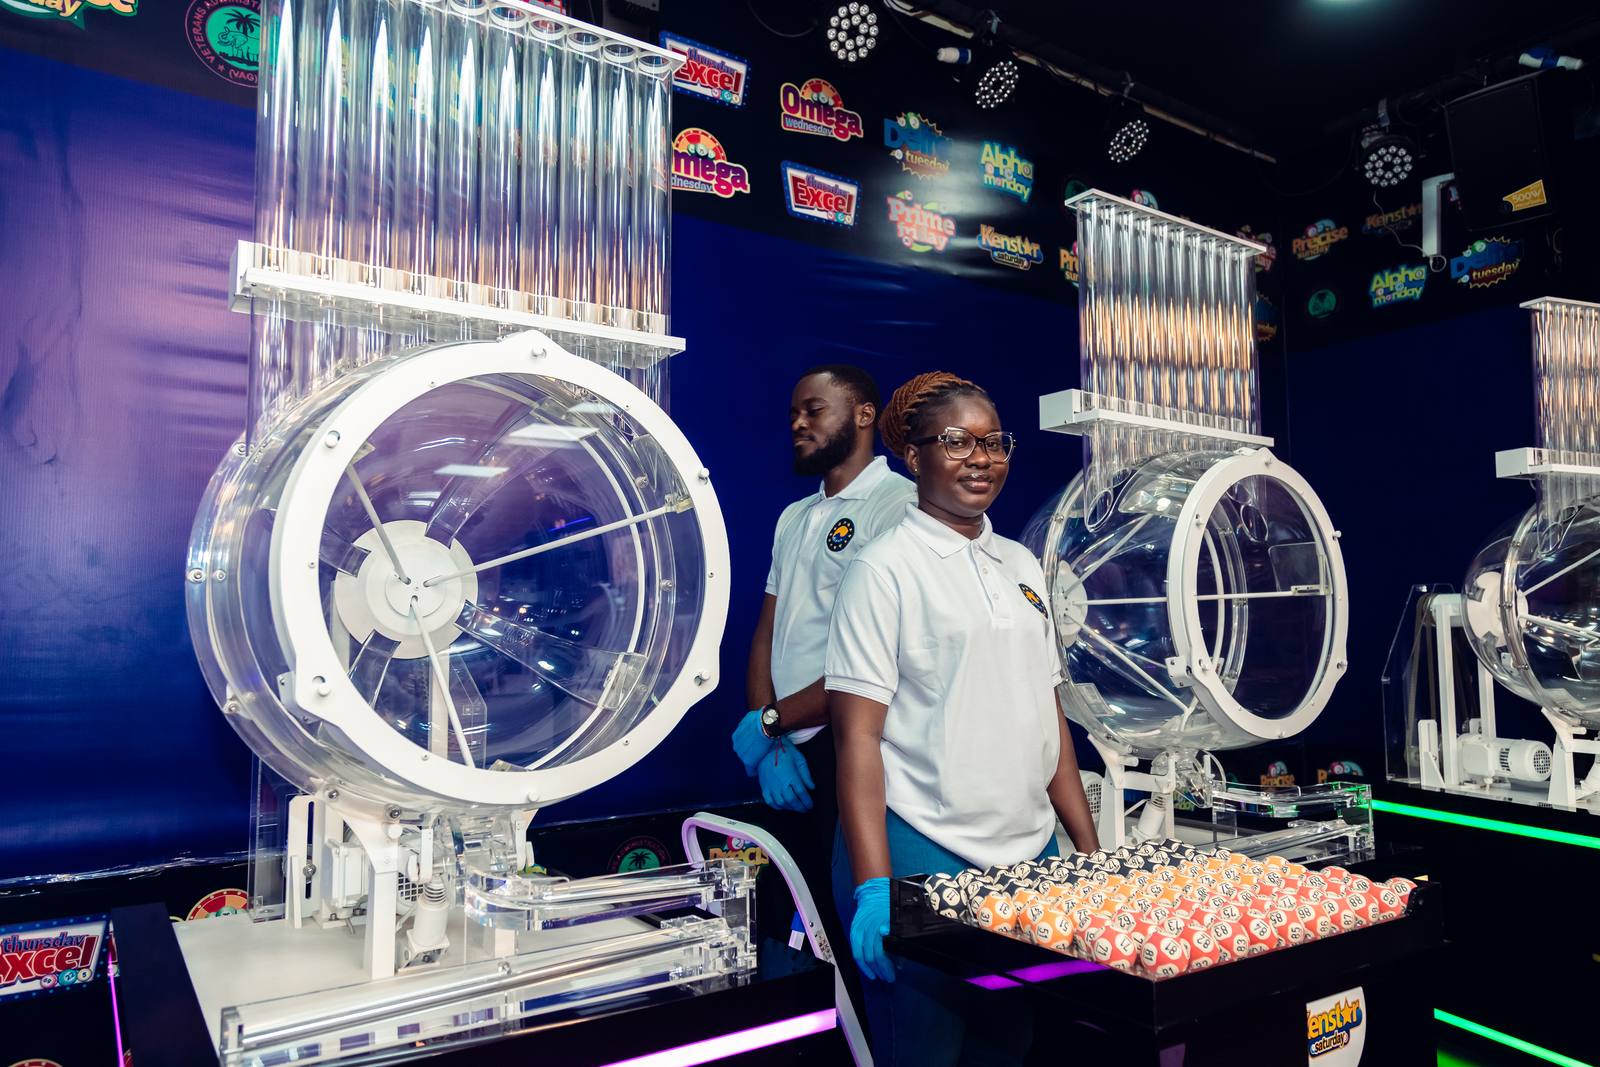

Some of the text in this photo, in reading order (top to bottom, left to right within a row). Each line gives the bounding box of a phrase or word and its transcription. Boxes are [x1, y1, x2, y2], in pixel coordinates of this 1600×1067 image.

[193, 7, 216, 64] VETERANS
[781, 84, 863, 140] Omega
[981, 143, 1033, 180] Alpha
[673, 149, 750, 197] mega
[672, 175, 713, 193] dnesday
[791, 175, 854, 215] Excel
[1371, 267, 1426, 291] Alpha
[1472, 261, 1520, 280] tuesday
[1349, 895, 1362, 907] 88
[1270, 913, 1283, 925] 85
[1298, 908, 1311, 919] 86
[1214, 924, 1228, 938] 83
[1164, 944, 1178, 956] 81
[1197, 935, 1211, 948] 82
[1236, 939, 1246, 952] 83
[0, 934, 99, 984] xcel
[1144, 948, 1154, 962] 81
